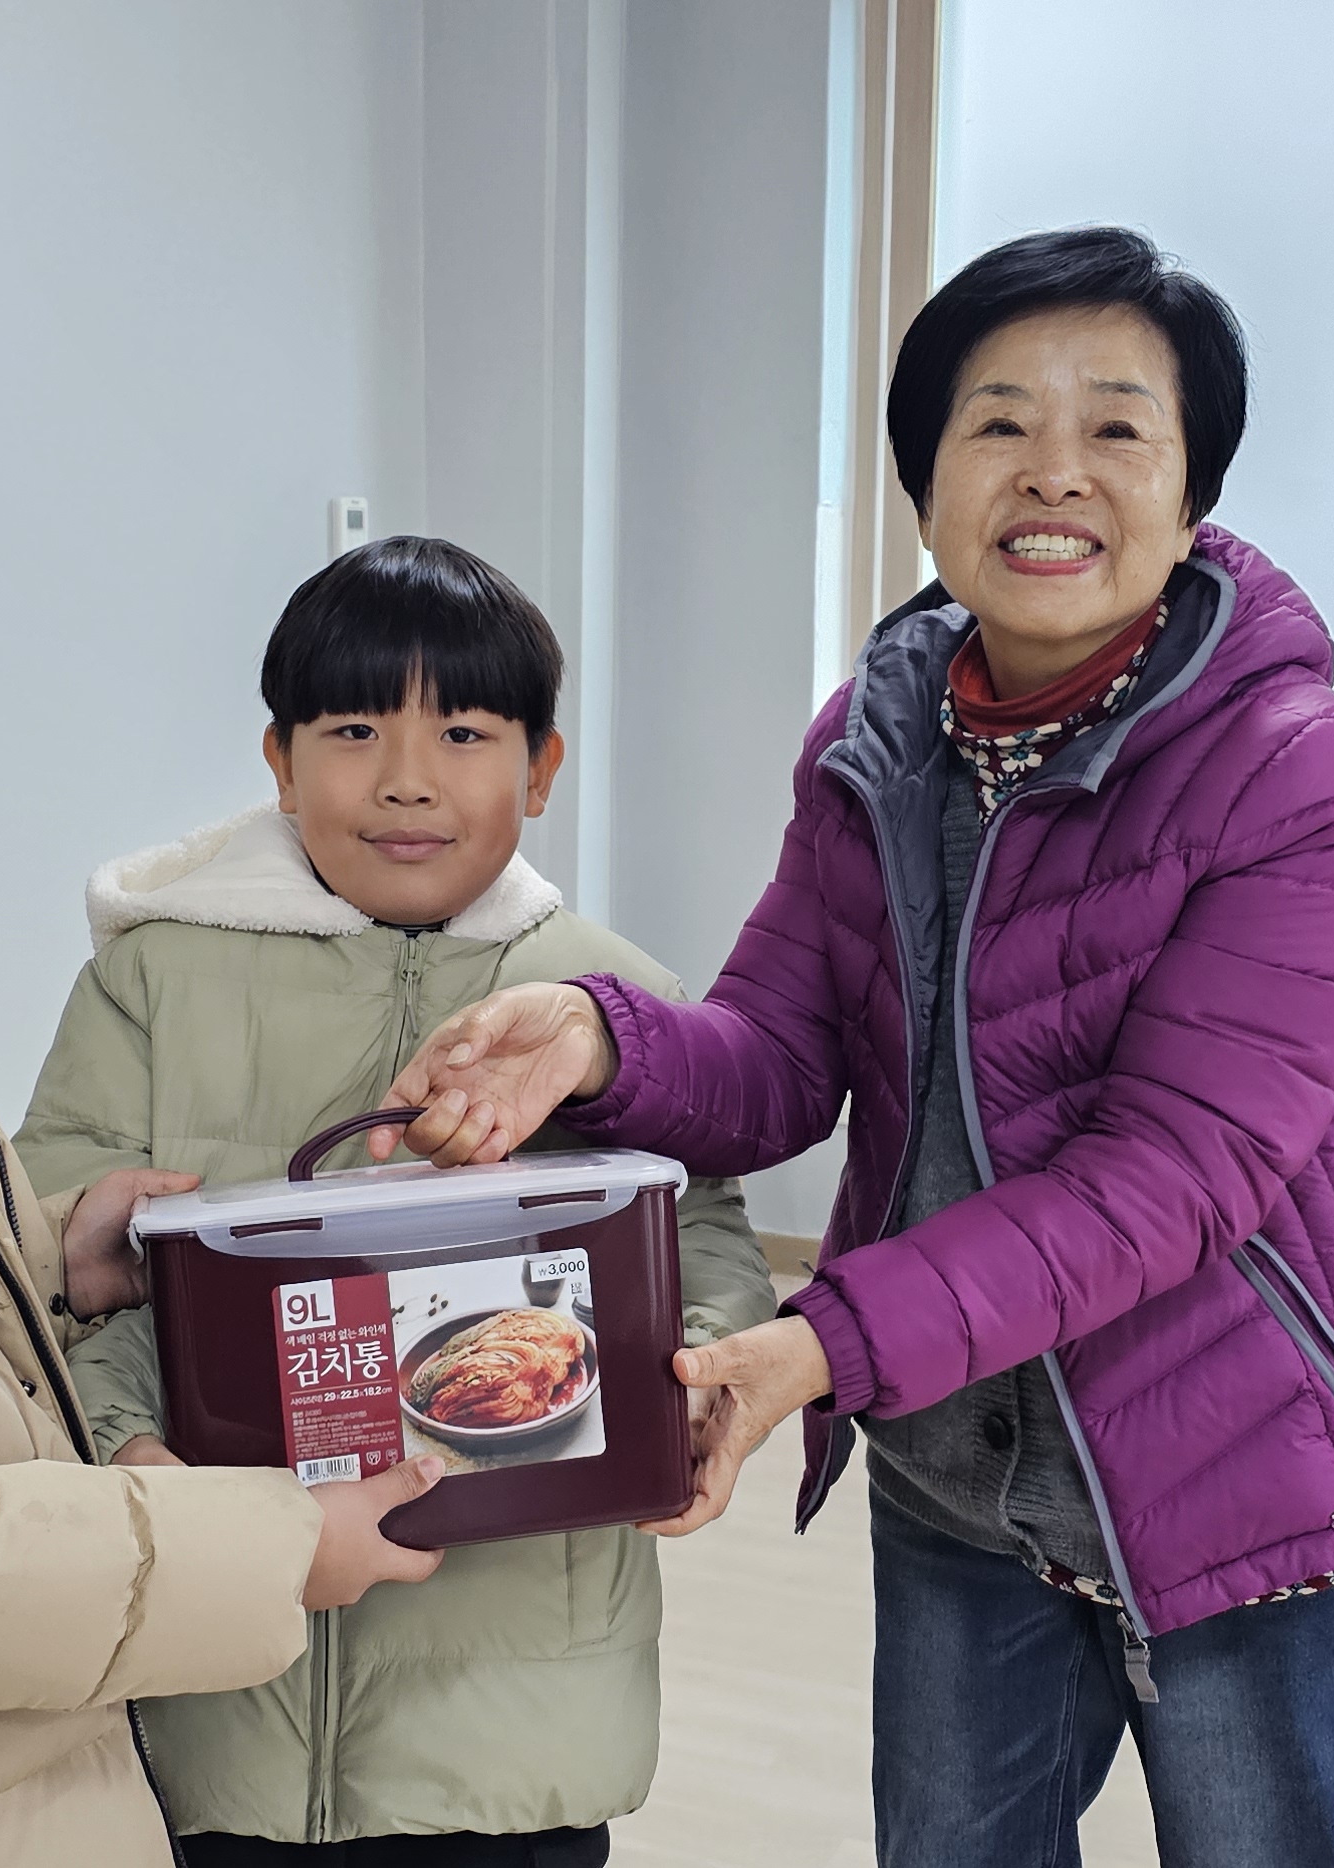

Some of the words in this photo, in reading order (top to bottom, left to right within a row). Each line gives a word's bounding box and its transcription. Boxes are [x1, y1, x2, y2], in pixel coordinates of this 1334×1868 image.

[287, 1293, 331, 1325] 9L
[317, 1330, 337, 1343] 걱정
[338, 1327, 358, 1341] 없는
[287, 1340, 389, 1387] 김치통
